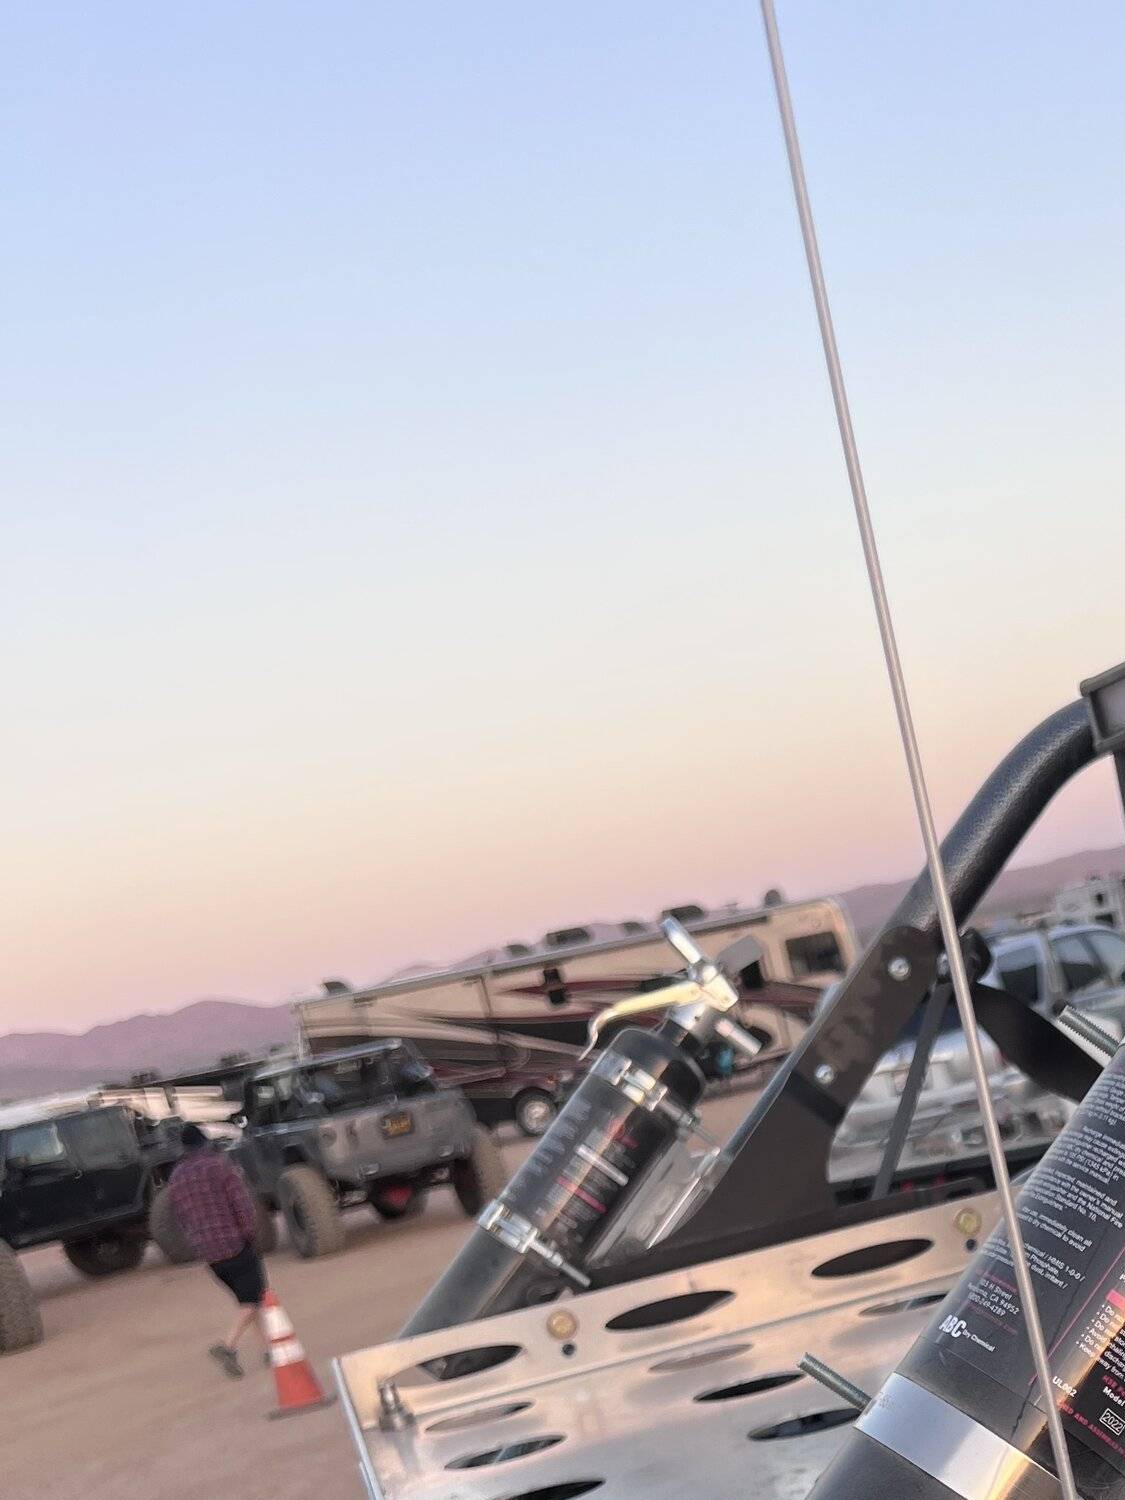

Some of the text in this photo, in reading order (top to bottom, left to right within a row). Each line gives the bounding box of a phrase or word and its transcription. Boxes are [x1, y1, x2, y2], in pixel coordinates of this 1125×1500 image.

[1101, 1158, 1114, 1169] and
[1112, 1173, 1119, 1181] in
[1103, 1195, 1117, 1206] and
[1066, 1191, 1123, 1228] and the National Fire
[1099, 1201, 1123, 1219] manual
[1061, 1234, 1069, 1242] to
[1066, 1228, 1084, 1242] clean
[1082, 1237, 1093, 1247] all
[1029, 1263, 1045, 1276] dust,
[1063, 1265, 1081, 1280] 1-0-0
[993, 1285, 1012, 1300] Street
[988, 1292, 1020, 1315] CA 94952
[937, 1311, 968, 1340] ABC
[969, 1332, 996, 1352] Chemical
[1109, 1365, 1125, 1380] from
[1101, 1385, 1125, 1407] Model
[1101, 1411, 1124, 1433] 2022
